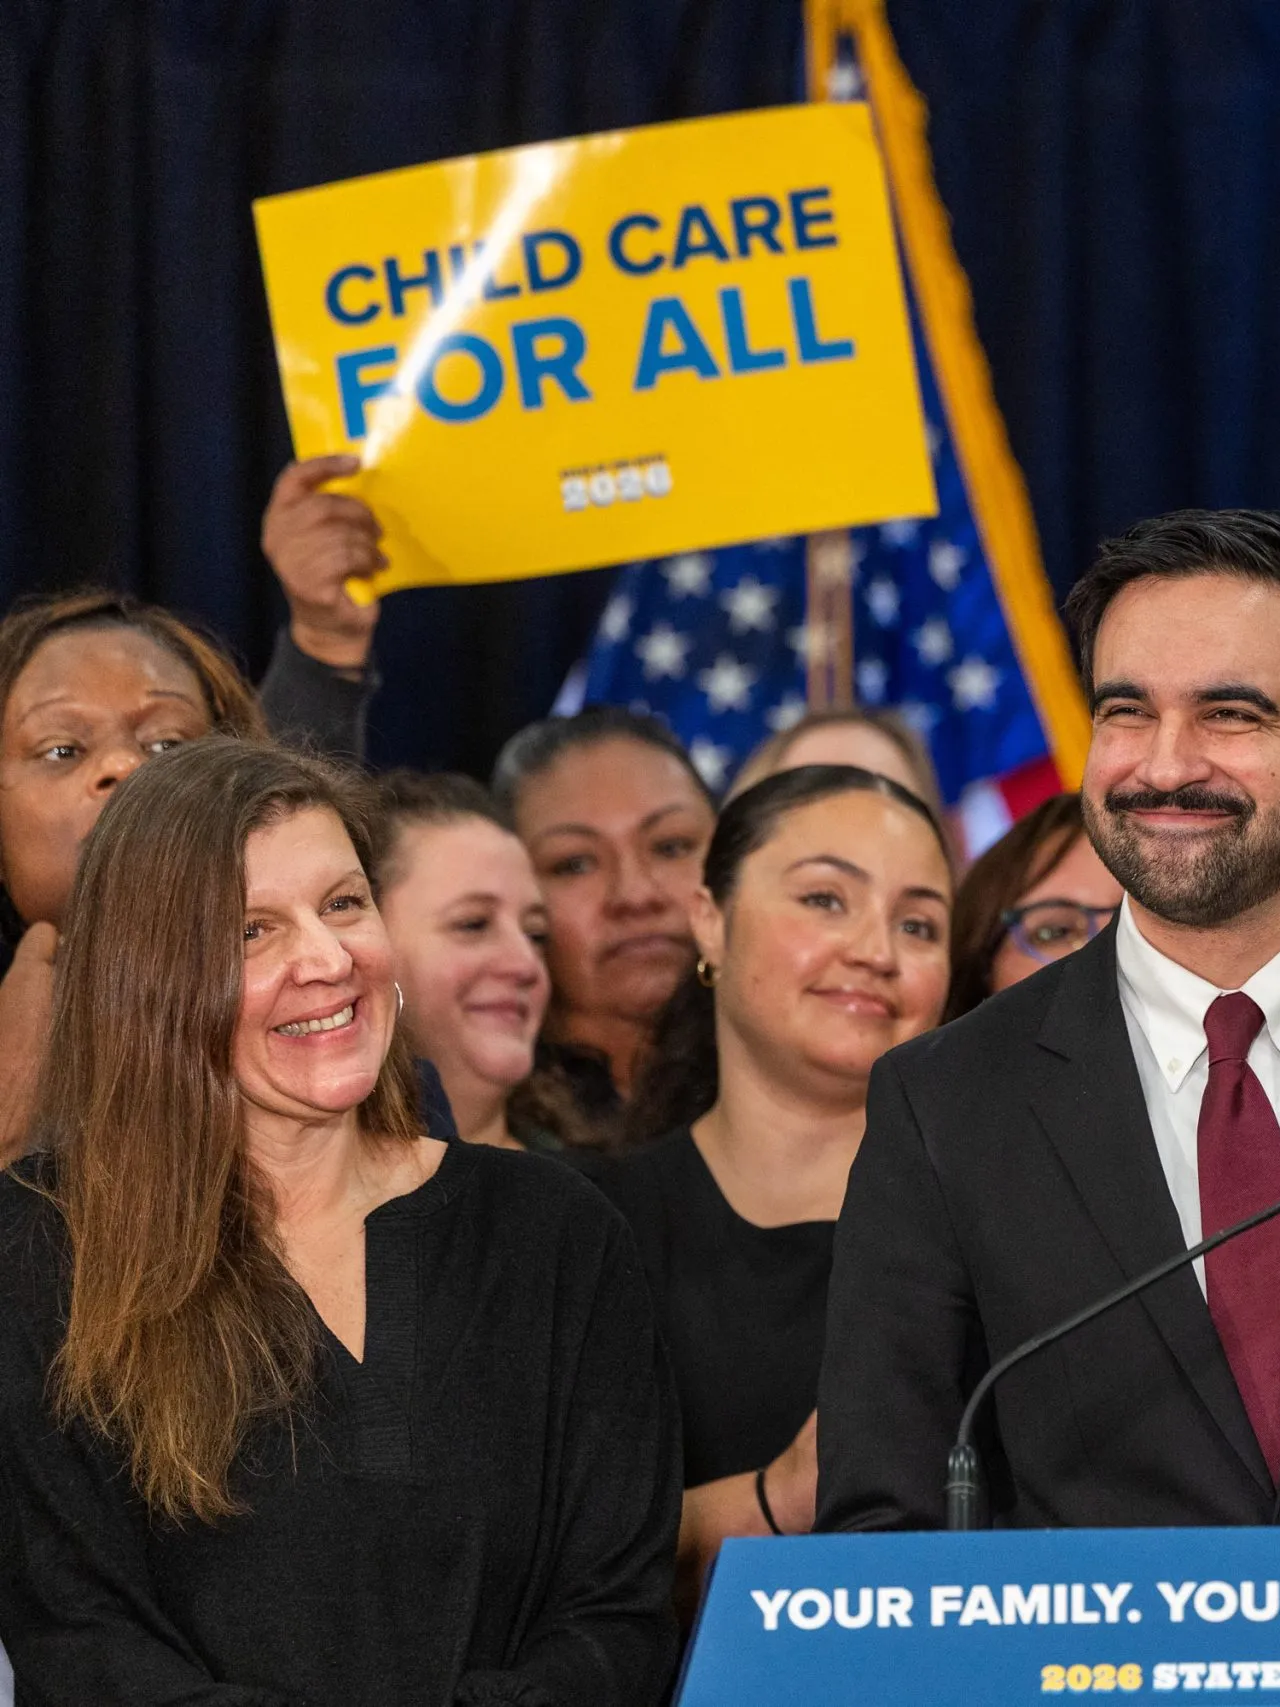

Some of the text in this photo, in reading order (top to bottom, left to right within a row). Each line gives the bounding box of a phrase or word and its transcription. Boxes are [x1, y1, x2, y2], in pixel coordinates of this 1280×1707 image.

[325, 187, 839, 326] CHILD CARE
[336, 277, 856, 440] FOR ALL
[561, 462, 673, 513] 2026
[750, 1586, 914, 1631] YOUR
[930, 1582, 1142, 1627] FAMILY.
[1040, 1663, 1143, 1692] 2026
